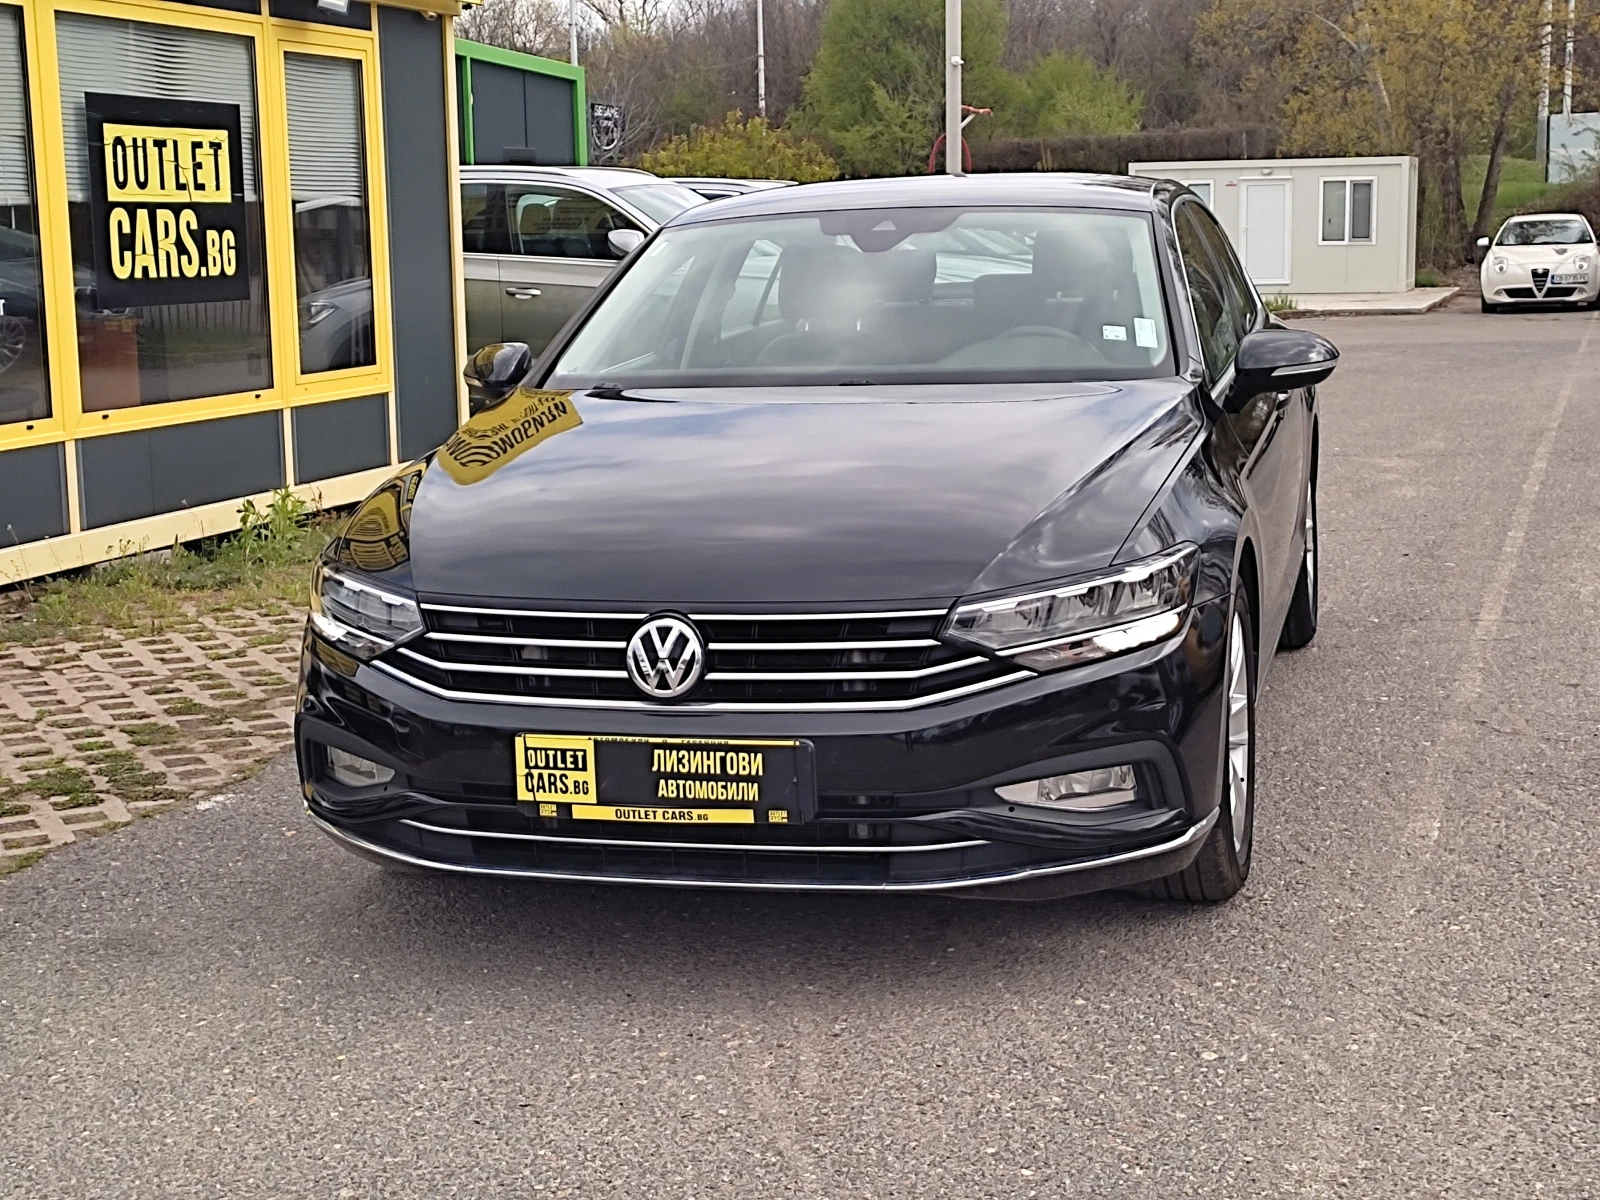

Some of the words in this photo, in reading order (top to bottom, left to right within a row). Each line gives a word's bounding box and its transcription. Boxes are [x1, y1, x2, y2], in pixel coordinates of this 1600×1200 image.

[112, 136, 222, 191] OUTLET
[109, 207, 236, 279] CARS.BG
[527, 749, 584, 769] OUTLET
[652, 749, 764, 776] ЛИЗИНГОВИ
[525, 771, 589, 795] CARS.BG
[658, 779, 759, 801] АВТОМОБИЛИ
[615, 808, 658, 821] OUTLET
